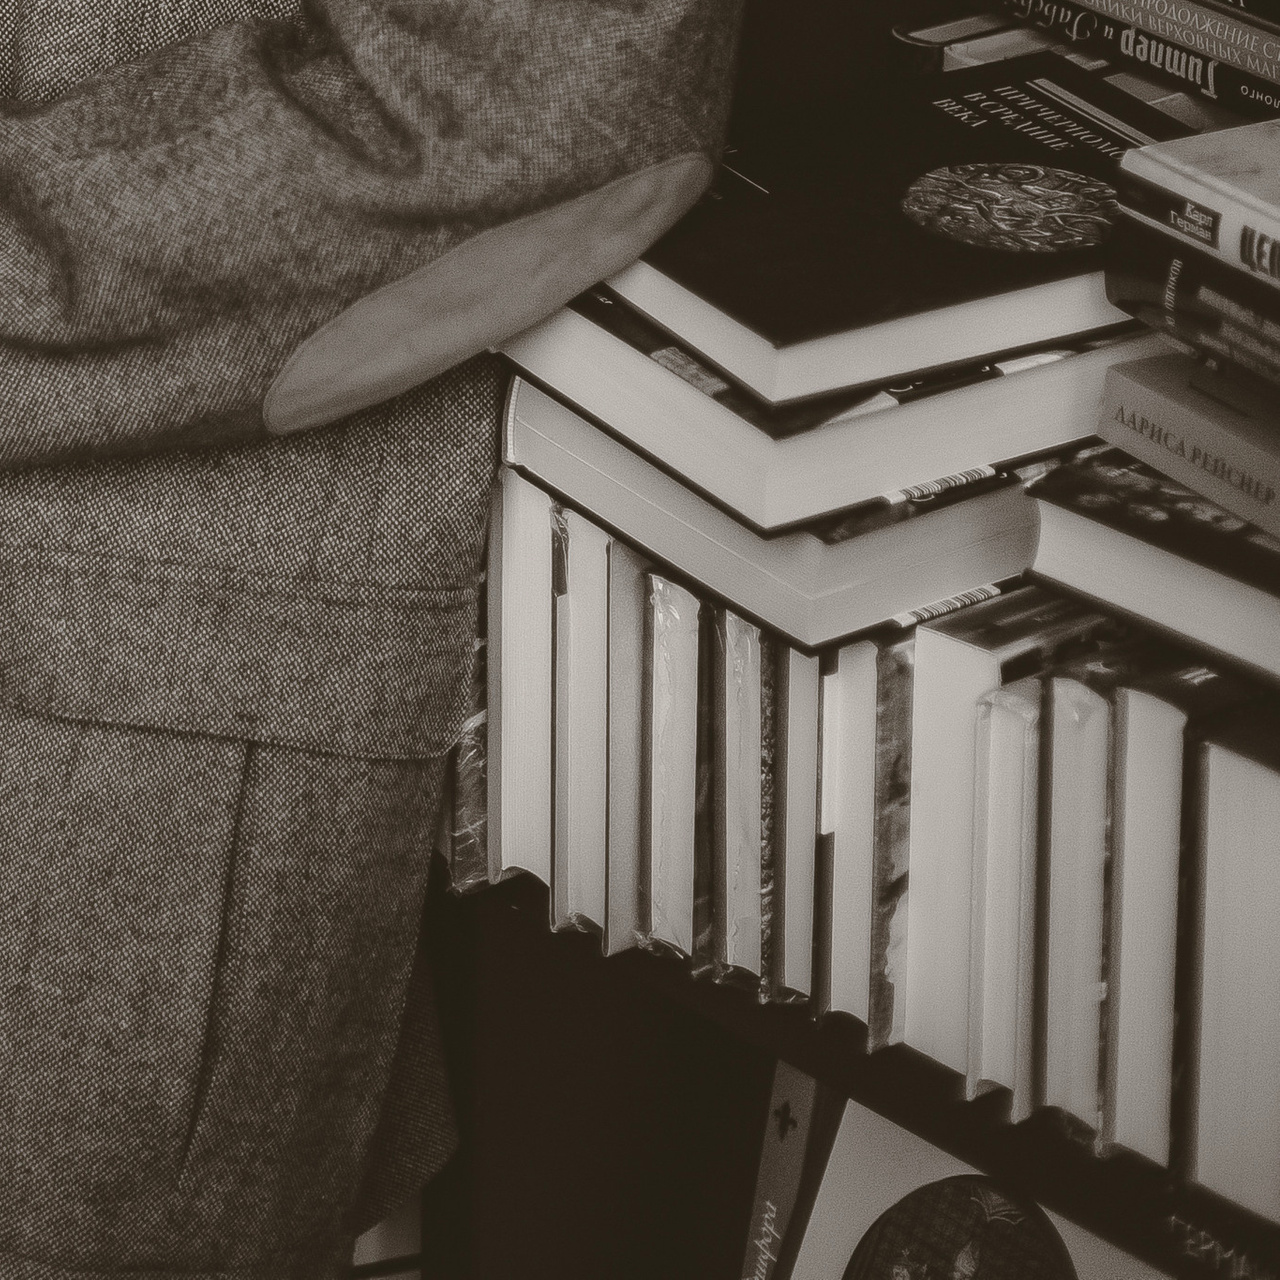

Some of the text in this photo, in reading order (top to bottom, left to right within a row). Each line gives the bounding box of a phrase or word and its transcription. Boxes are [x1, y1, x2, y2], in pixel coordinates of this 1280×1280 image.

[1119, 27, 1218, 100] Гитлер
[1147, 13, 1243, 65] ВЕРХОВНЫХ
[931, 97, 988, 129] ВЕКА
[977, 98, 1075, 152] СРЕДНИЕ
[1169, 210, 1213, 240] Герман
[1184, 203, 1213, 226] Карл
[1114, 405, 1277, 506] ЛАРИСА РЕЙСНЕР
